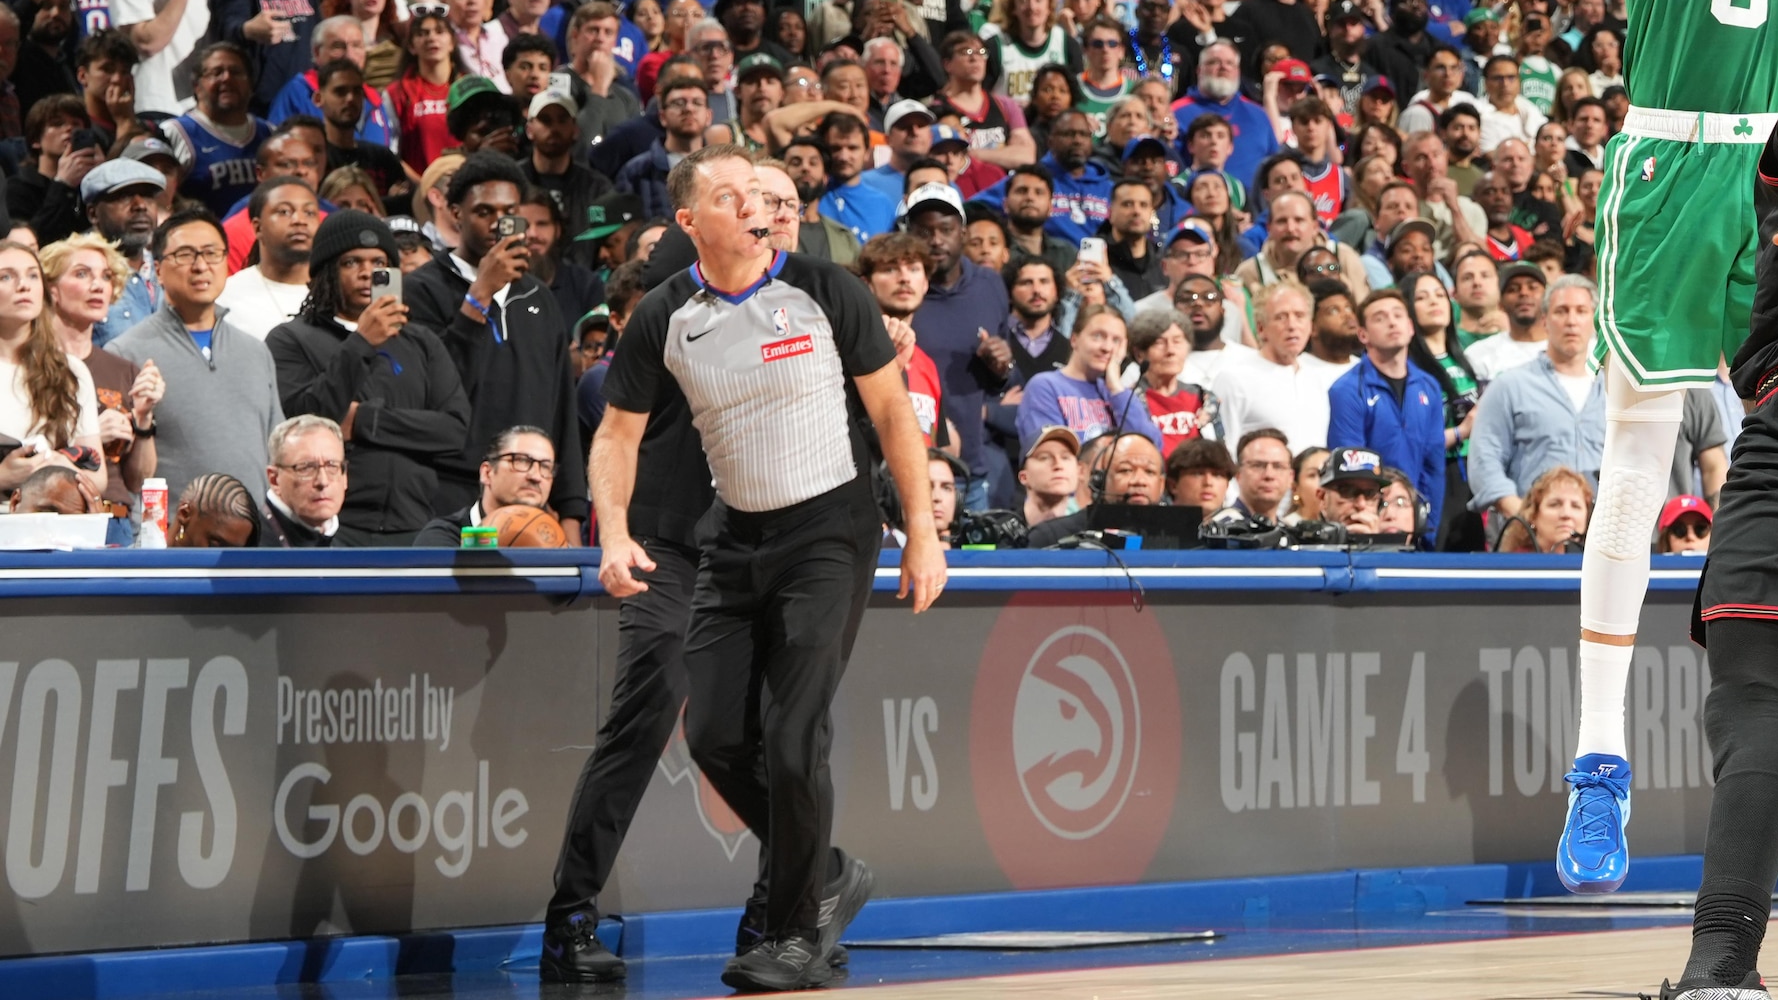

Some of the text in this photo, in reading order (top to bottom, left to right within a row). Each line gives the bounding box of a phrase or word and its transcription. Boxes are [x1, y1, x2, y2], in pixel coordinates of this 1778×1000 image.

[762, 338, 812, 360] Emirates
[277, 674, 455, 752] Presented by
[882, 696, 939, 811] VS
[1219, 651, 1381, 813] GAME
[1396, 651, 1430, 802] 4
[0, 655, 249, 899] OFFS
[273, 760, 529, 878] Google
